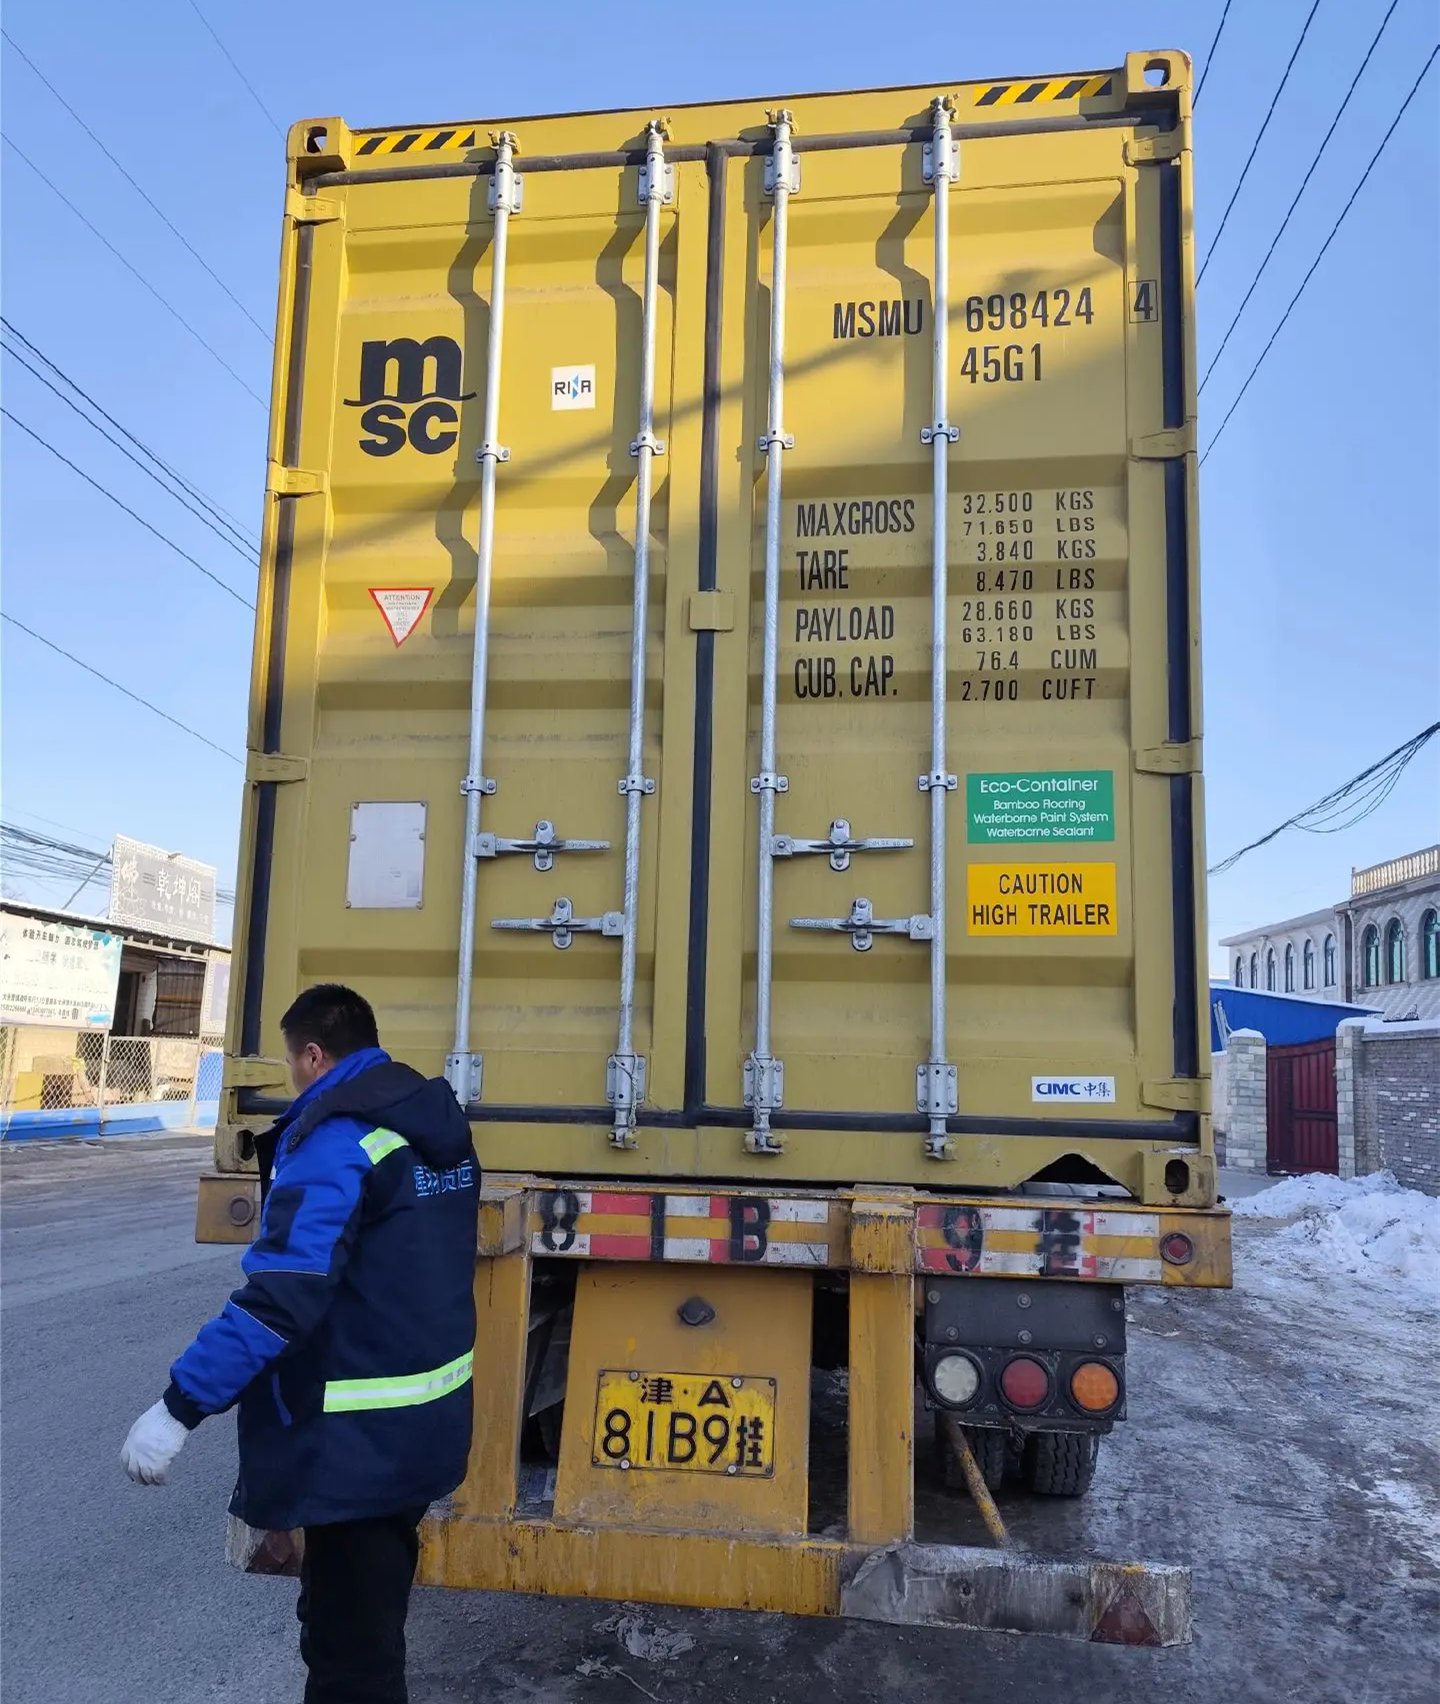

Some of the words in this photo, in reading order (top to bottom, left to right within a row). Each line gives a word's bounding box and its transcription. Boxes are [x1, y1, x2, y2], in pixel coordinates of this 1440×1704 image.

[833, 300, 924, 340] MSMU
[965, 287, 1096, 333] 698424
[1133, 283, 1154, 321] 4
[959, 343, 1043, 384] 45G1
[796, 498, 916, 538] MAXGROSS
[963, 491, 1034, 516] 32.500
[1055, 489, 1095, 512] KGS
[963, 519, 1034, 537] 71.650
[1056, 516, 1096, 534] LBS
[796, 549, 850, 591] TARE
[977, 539, 1034, 563] 3.840
[1057, 538, 1097, 561] KGS
[976, 569, 1034, 593] 8.470
[1056, 567, 1096, 591] LBS
[795, 605, 895, 643] PAYLOAD
[962, 599, 1034, 622] 28.660
[1056, 597, 1096, 620] KGS
[962, 625, 1034, 644] 63.180
[1056, 624, 1096, 641] LBS
[794, 657, 844, 699] CUB.
[850, 654, 898, 697] CAP.
[976, 650, 1020, 672] 76.4
[1050, 648, 1098, 670] CUM
[962, 679, 1019, 702] 2.700
[1042, 677, 1097, 701] CUFT
[980, 778, 1099, 794] Eco-Container
[993, 800, 1040, 810] Bamboo
[974, 813, 1037, 825] Waterborne
[1040, 812, 1067, 823] Paint
[1069, 811, 1109, 825] System
[987, 827, 1050, 838] Waterborne
[1052, 825, 1095, 837] Sealant
[999, 873, 1083, 895] CAUTION
[972, 904, 1017, 926] HIGH
[1028, 903, 1111, 926] TRAILER
[1035, 1083, 1081, 1095] CIMC
[1083, 1082, 1111, 1097] 中集
[603, 1408, 764, 1468] 81B9挂
